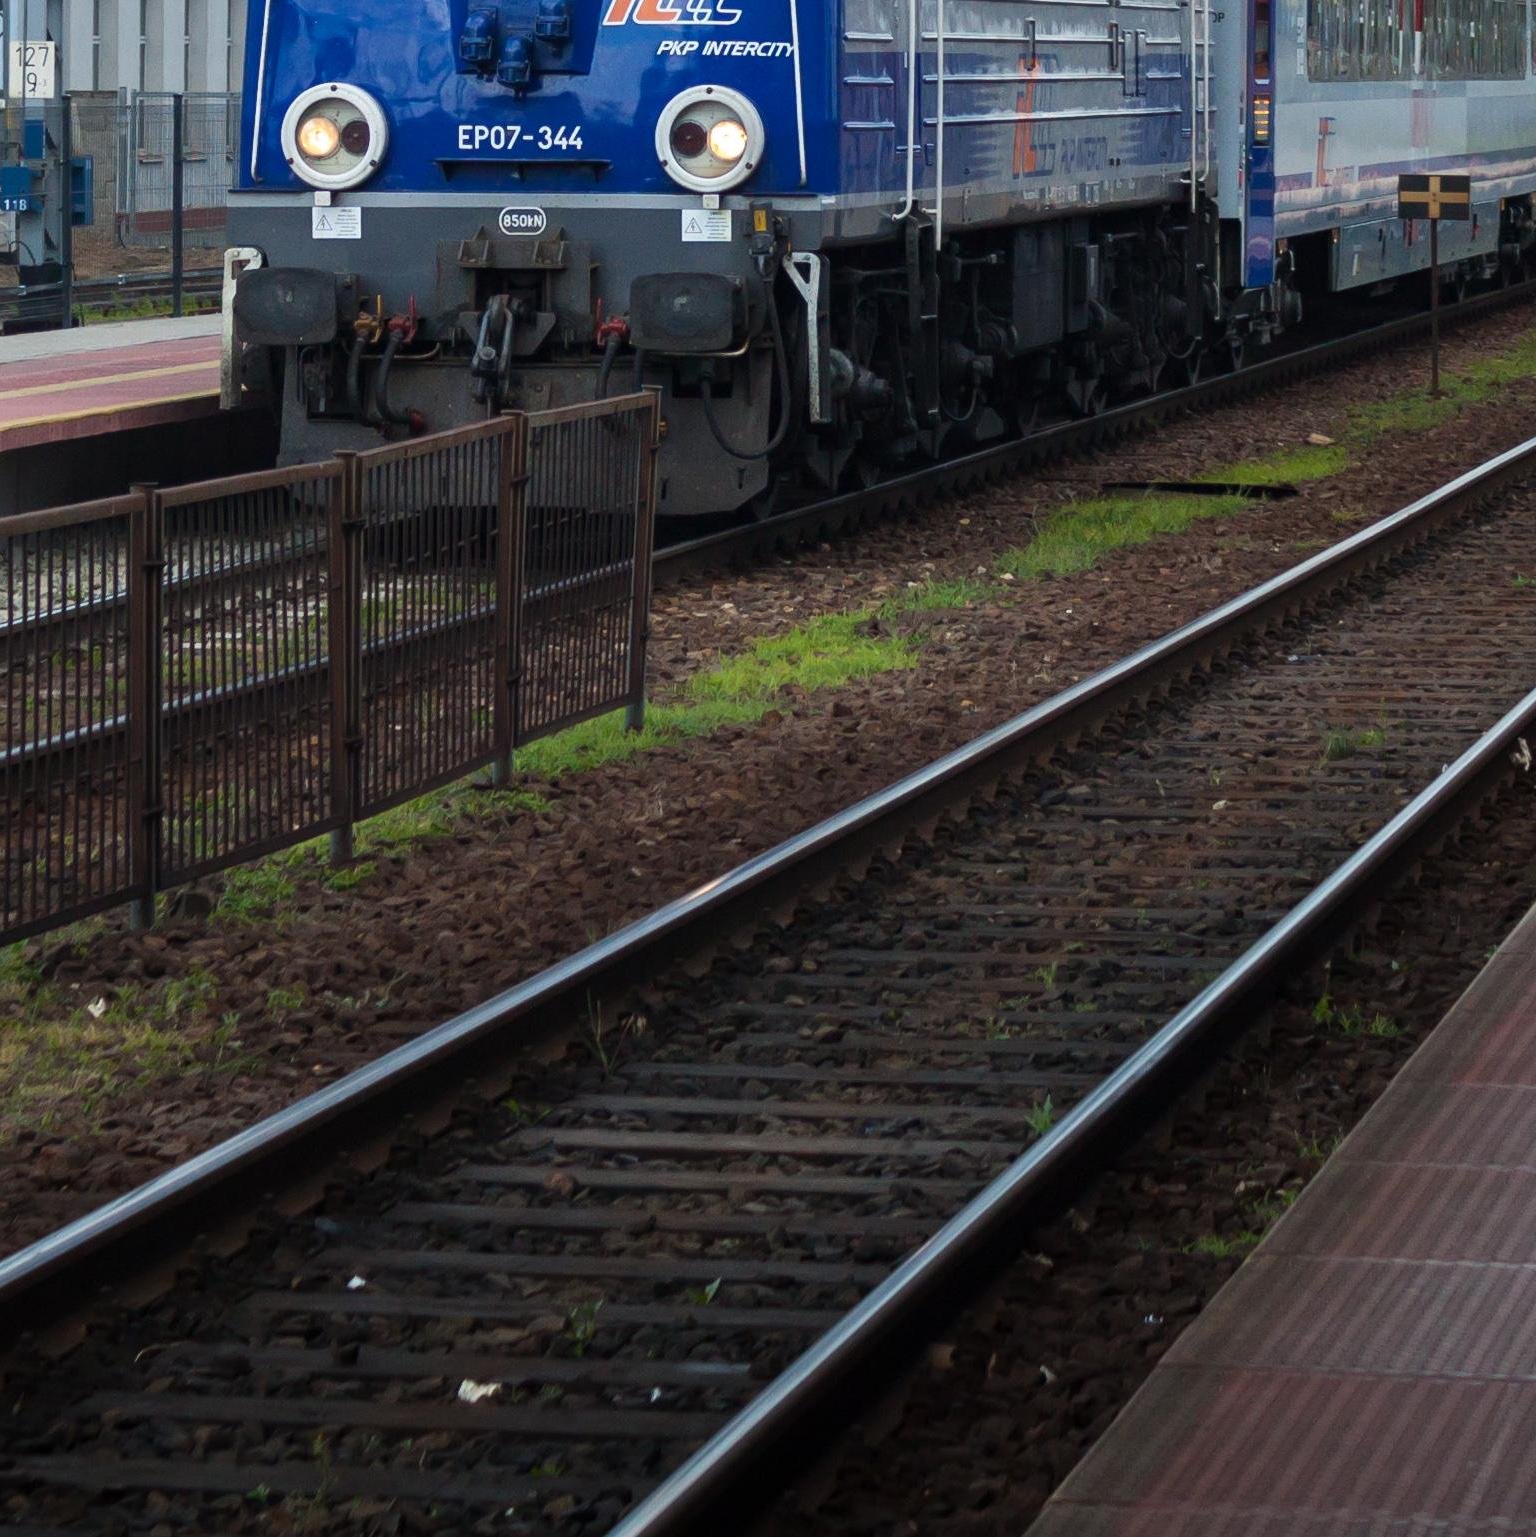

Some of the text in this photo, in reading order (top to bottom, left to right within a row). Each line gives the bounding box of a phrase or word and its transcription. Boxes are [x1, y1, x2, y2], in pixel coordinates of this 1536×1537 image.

[15, 46, 50, 67] 127
[656, 40, 795, 57] PKP INTERCITY
[457, 124, 584, 150] EP07-344
[502, 214, 544, 228] 850kN
